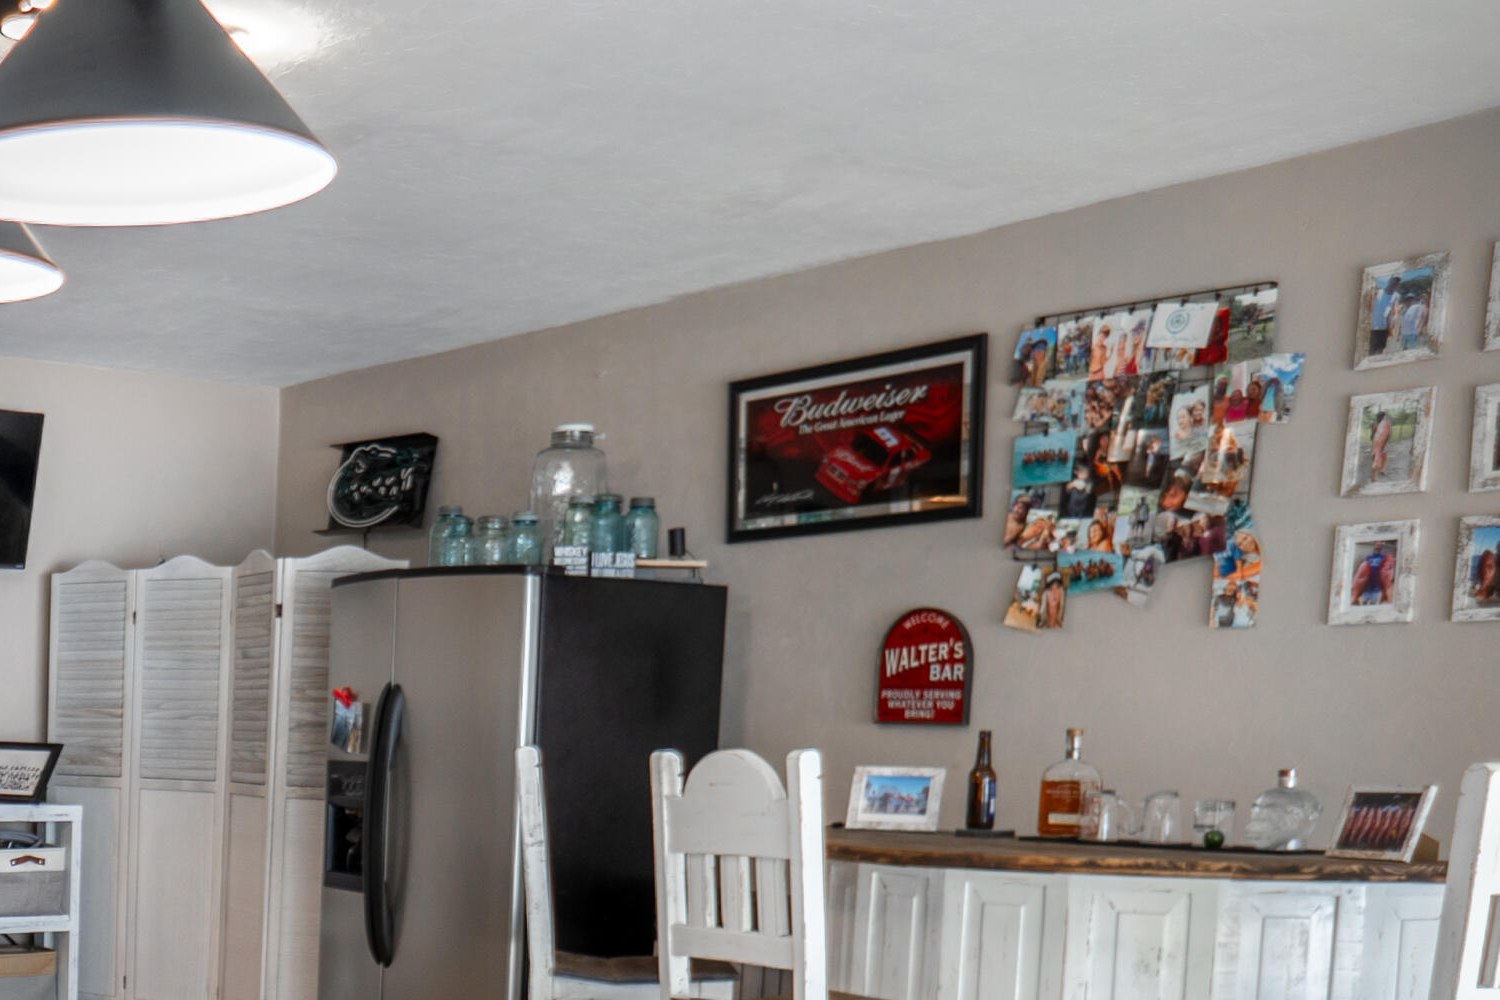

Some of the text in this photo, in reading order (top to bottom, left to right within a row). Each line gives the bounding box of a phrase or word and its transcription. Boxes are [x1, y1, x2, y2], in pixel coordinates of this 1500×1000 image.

[773, 383, 930, 428] Budweiser
[799, 410, 905, 434] The Great American Lager
[902, 611, 950, 630] WELCOME
[885, 637, 964, 678] WALTER'S
[929, 663, 965, 682] BAR
[881, 690, 962, 700] PROUDLY SERVING
[888, 700, 955, 710] WHATEVER YOU
